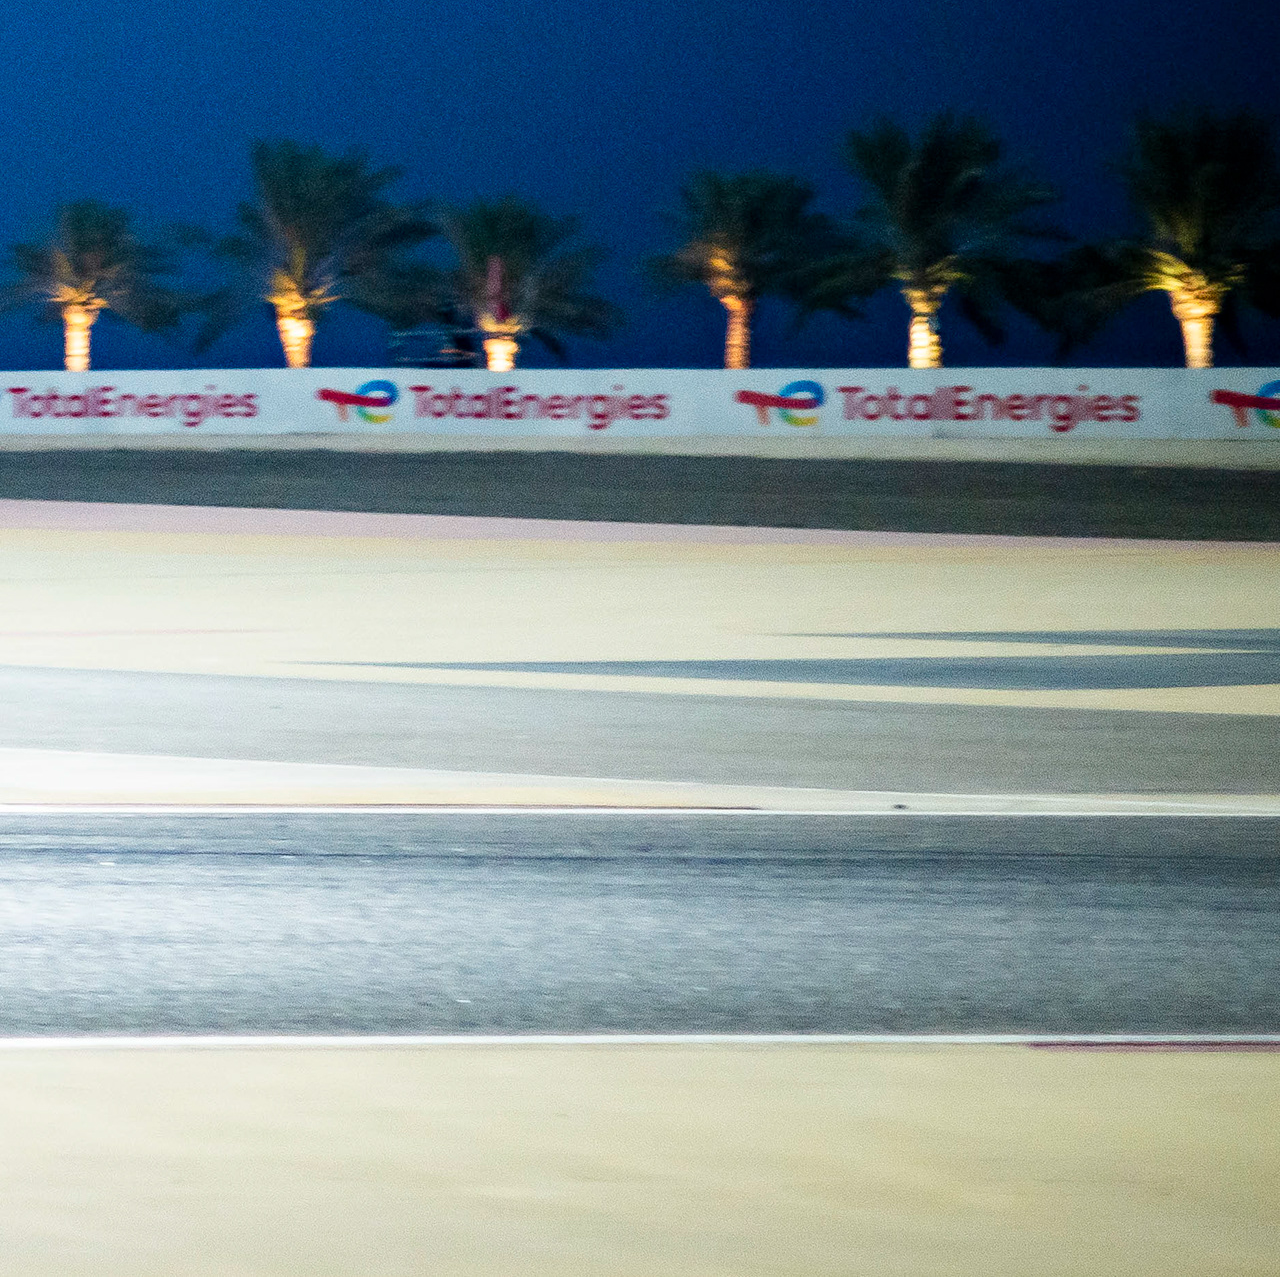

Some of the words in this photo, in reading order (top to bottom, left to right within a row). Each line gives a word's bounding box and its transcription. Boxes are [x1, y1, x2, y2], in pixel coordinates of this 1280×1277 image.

[7, 385, 259, 428] TotalEnergies
[408, 385, 670, 429] TotalEnergies
[836, 384, 1140, 433] TotalEnergies
